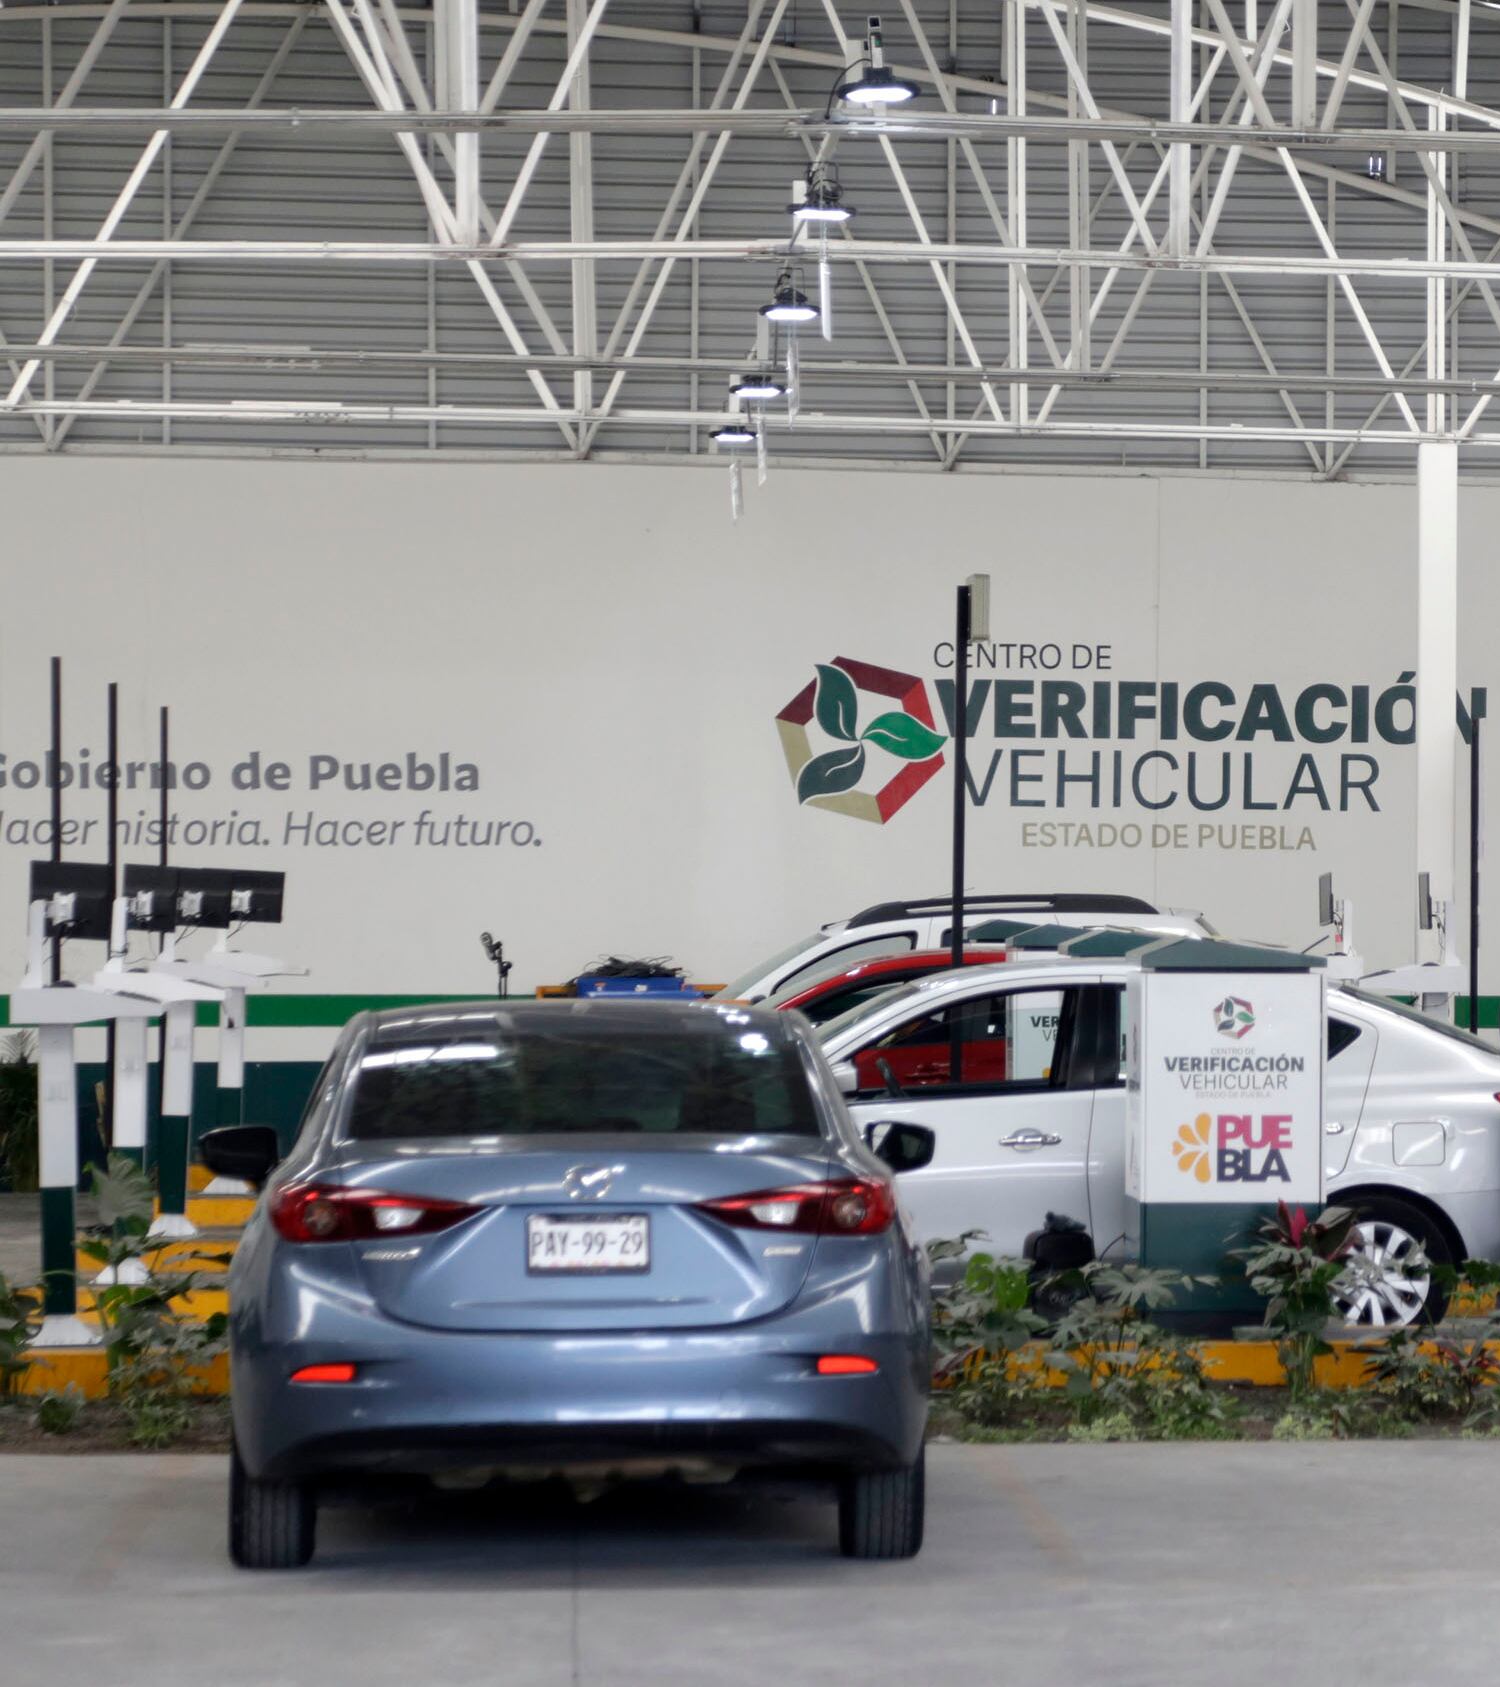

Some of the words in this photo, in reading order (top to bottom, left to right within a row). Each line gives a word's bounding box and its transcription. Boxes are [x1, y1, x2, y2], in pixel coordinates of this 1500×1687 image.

[933, 642, 1062, 670] CENTRO
[1072, 644, 1112, 670] DE
[0, 748, 211, 790] obierno
[231, 751, 291, 791] de
[309, 751, 479, 792] Puebla
[958, 748, 1380, 812] VEHICULAR
[0, 810, 98, 845] acer
[283, 810, 404, 847] Hacer
[413, 810, 542, 847] futuro.
[1022, 822, 1142, 848] ESTADO
[1150, 824, 1188, 849] DE
[1198, 824, 1317, 851] PUEBLA
[1164, 1053, 1304, 1072] VERIFICACIÓN
[1180, 1074, 1288, 1090] VEHICULAR
[1217, 1115, 1293, 1149] PUE
[1217, 1148, 1292, 1182] BLA
[531, 1231, 643, 1256] PAY-99-29
